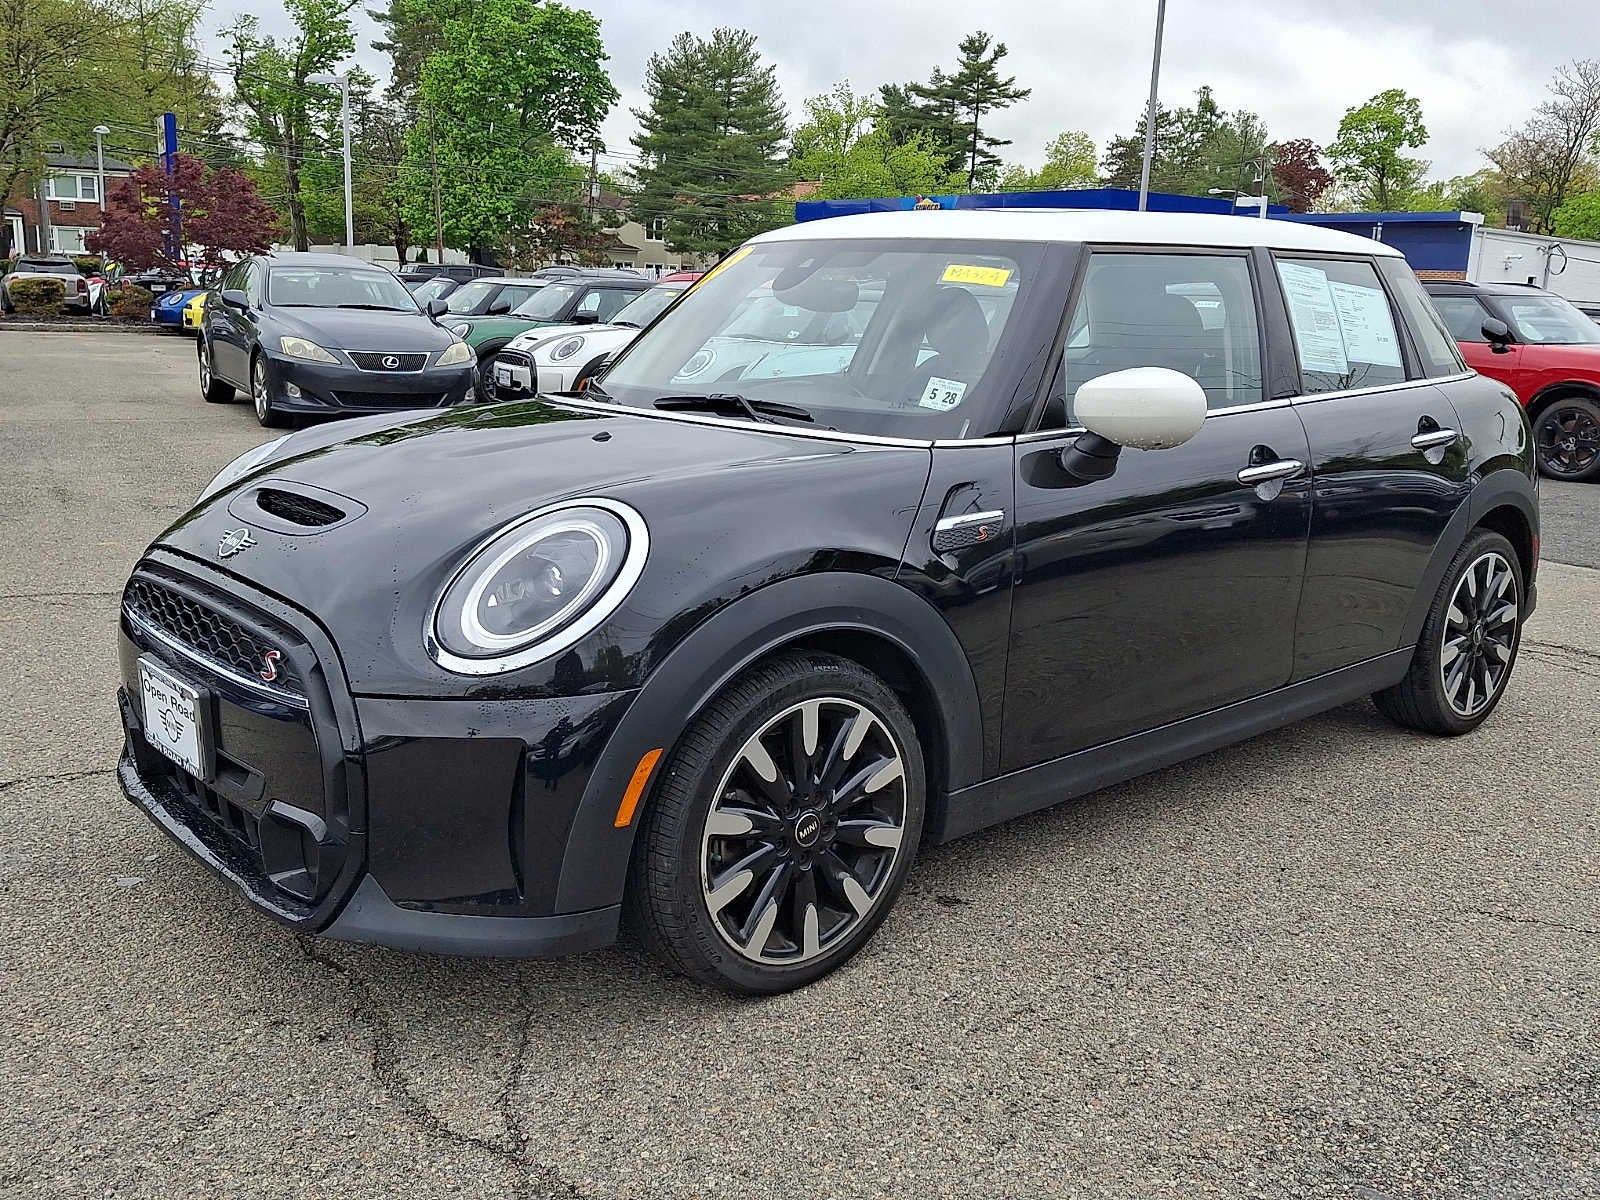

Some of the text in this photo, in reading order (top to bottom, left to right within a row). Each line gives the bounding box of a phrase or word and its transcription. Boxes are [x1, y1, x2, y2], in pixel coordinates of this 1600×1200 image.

[929, 388, 939, 400] 5
[942, 391, 957, 405] 28
[975, 525, 988, 541] S
[260, 650, 281, 681] S
[144, 678, 196, 722] Open Road
[799, 821, 817, 839] MINI
